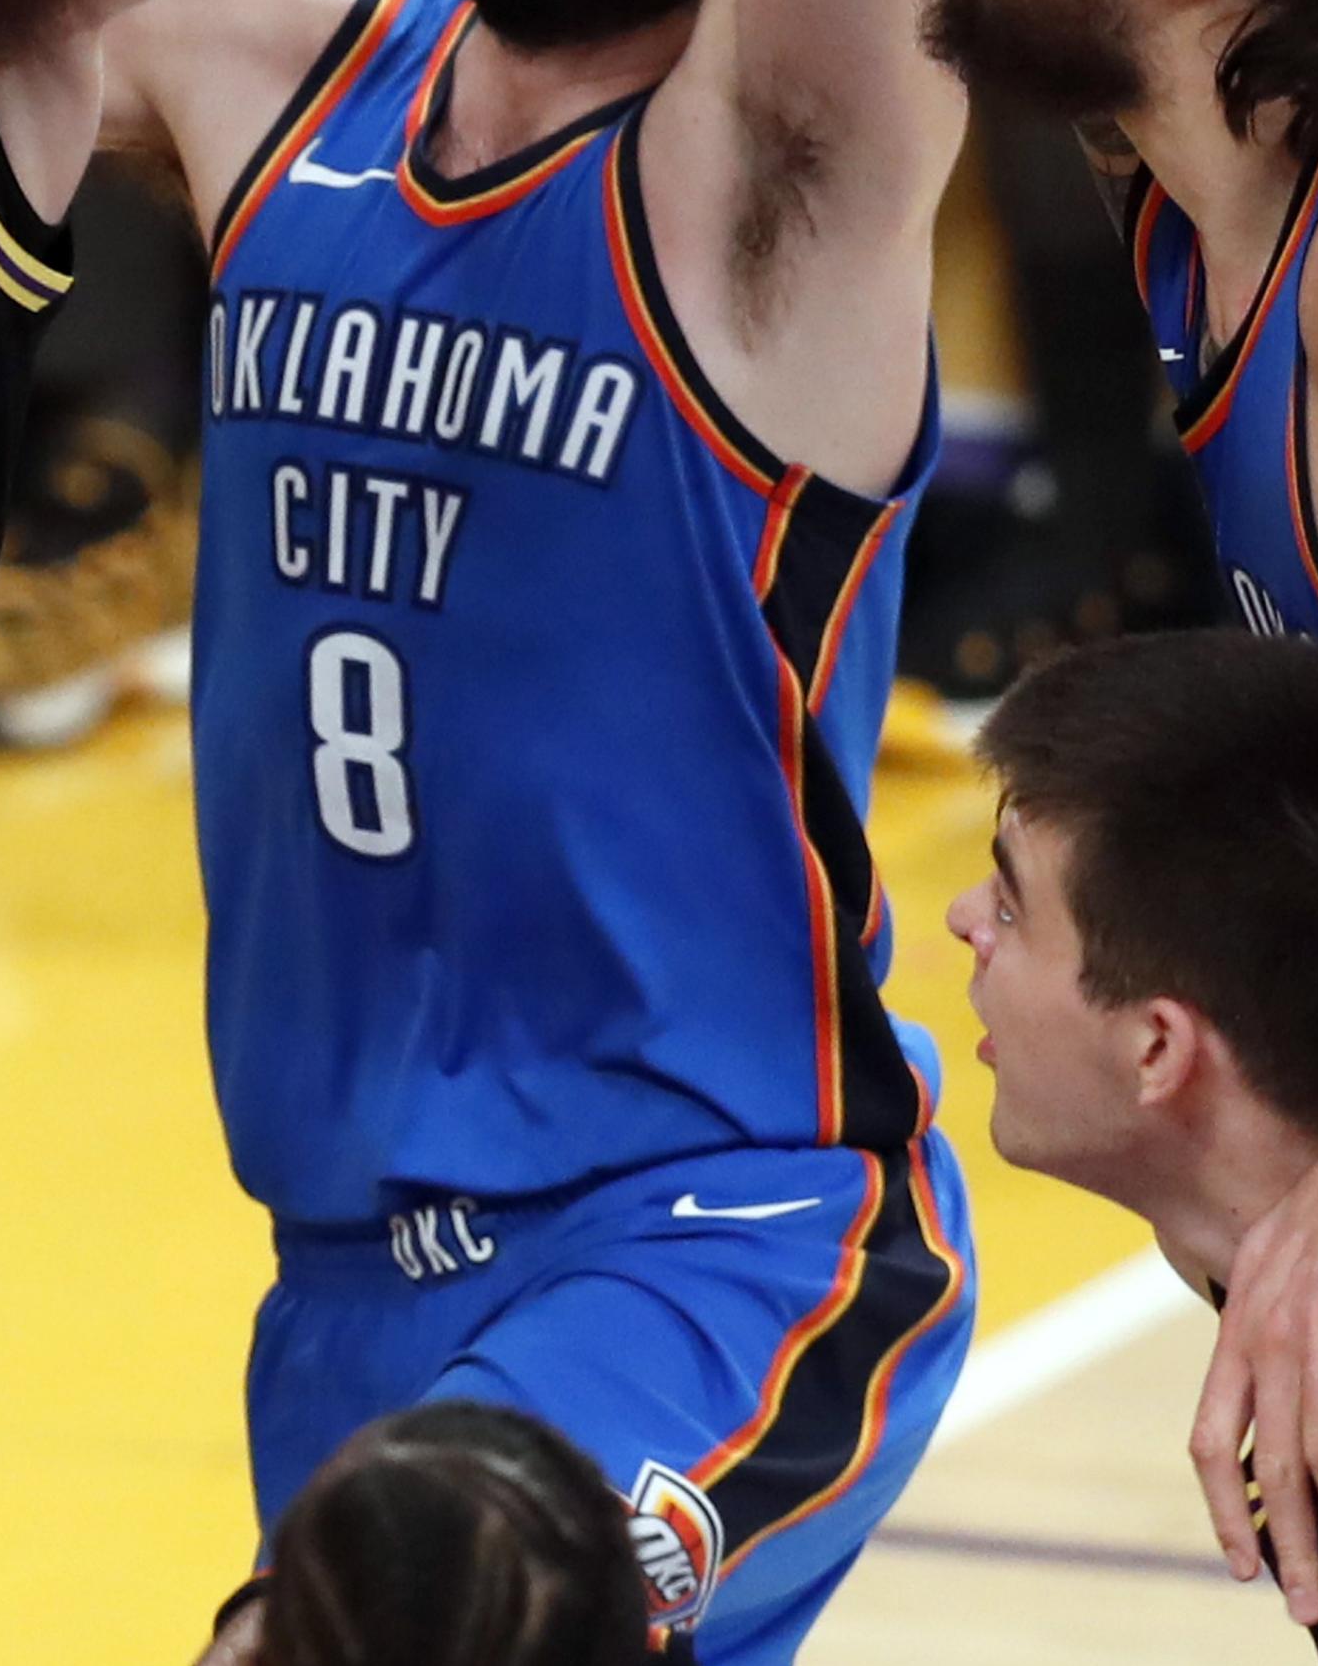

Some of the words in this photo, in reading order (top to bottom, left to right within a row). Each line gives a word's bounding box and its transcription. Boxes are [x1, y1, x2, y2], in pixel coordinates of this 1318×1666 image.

[209, 293, 637, 481] OKLAHOMA
[273, 464, 464, 604] CITY
[306, 629, 418, 860] 8
[389, 1197, 495, 1281] OKC
